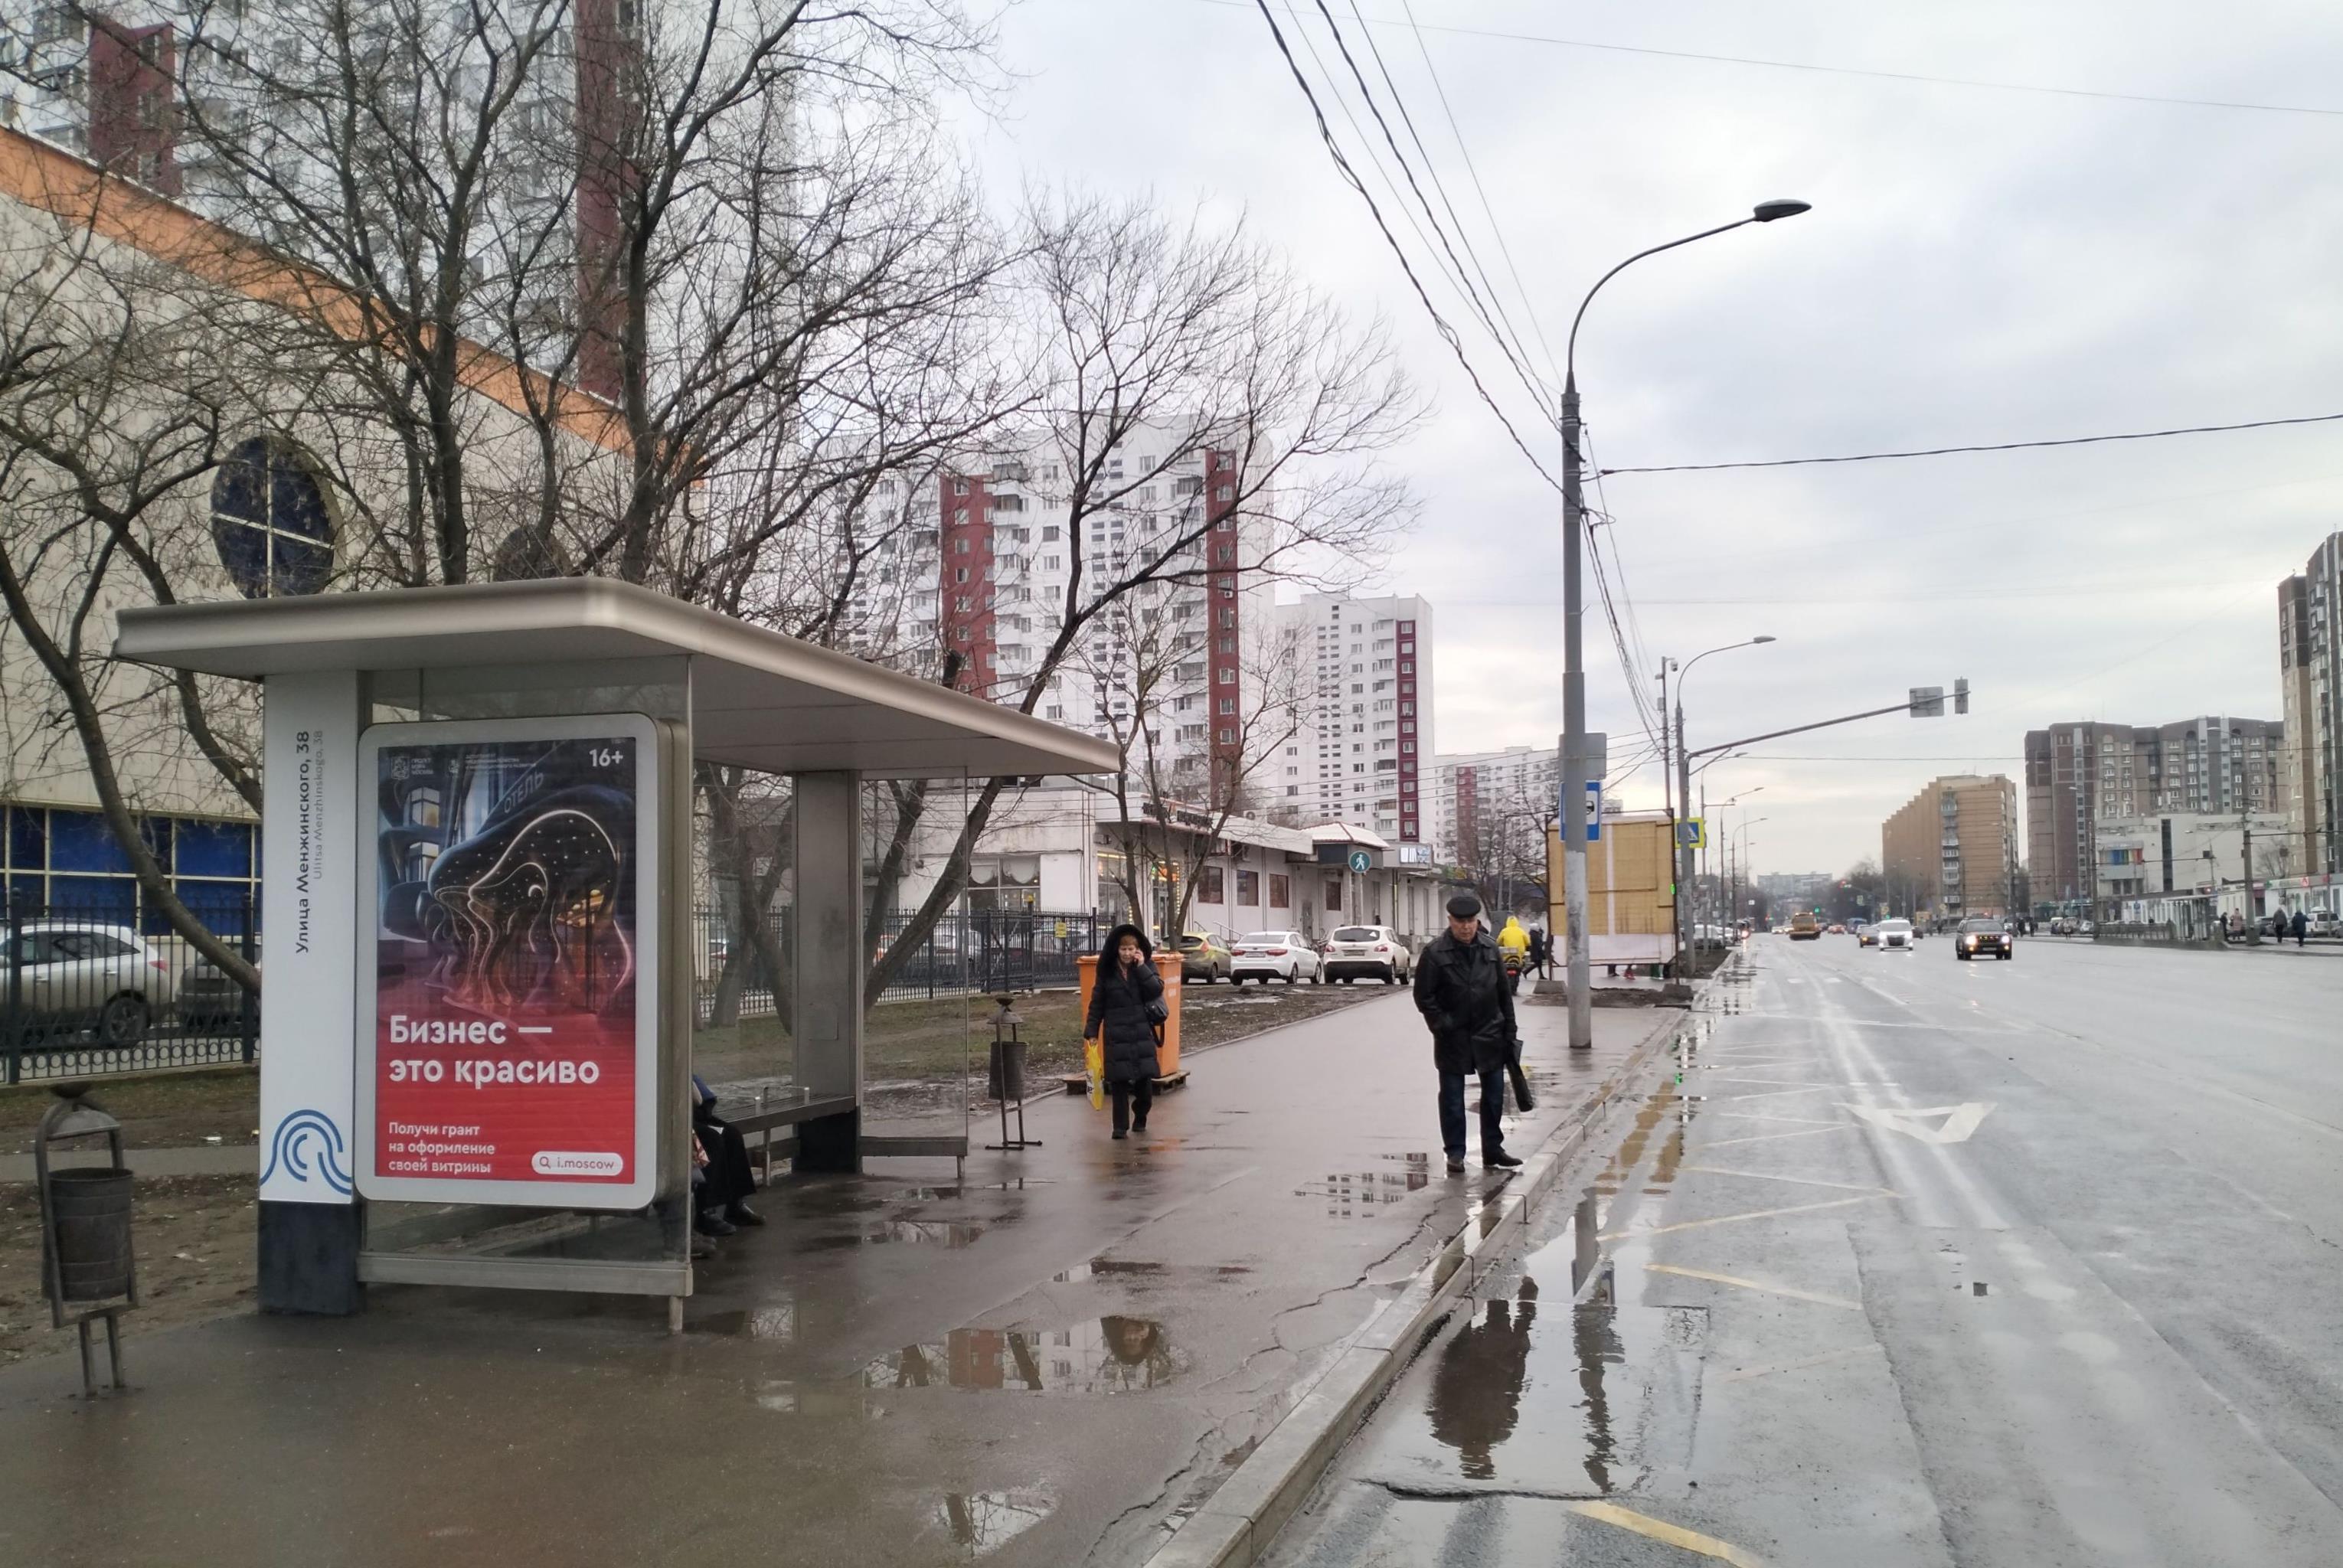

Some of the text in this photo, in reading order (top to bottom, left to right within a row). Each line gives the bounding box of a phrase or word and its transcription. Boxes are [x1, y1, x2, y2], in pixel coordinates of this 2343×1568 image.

[313, 730, 323, 745] 38
[589, 748, 624, 767] 16+
[504, 771, 544, 814] ОТЕЛЬ
[296, 730, 312, 953] Улица Менжинского, 38
[313, 844, 322, 880] Ulitsa
[390, 1015, 506, 1044] Бизнес
[389, 1060, 600, 1089] это красиво
[389, 1122, 480, 1138] Получи грант
[389, 1139, 495, 1156] на оформление
[388, 1157, 492, 1175] своей витрины
[557, 1157, 615, 1170] i.moscow
